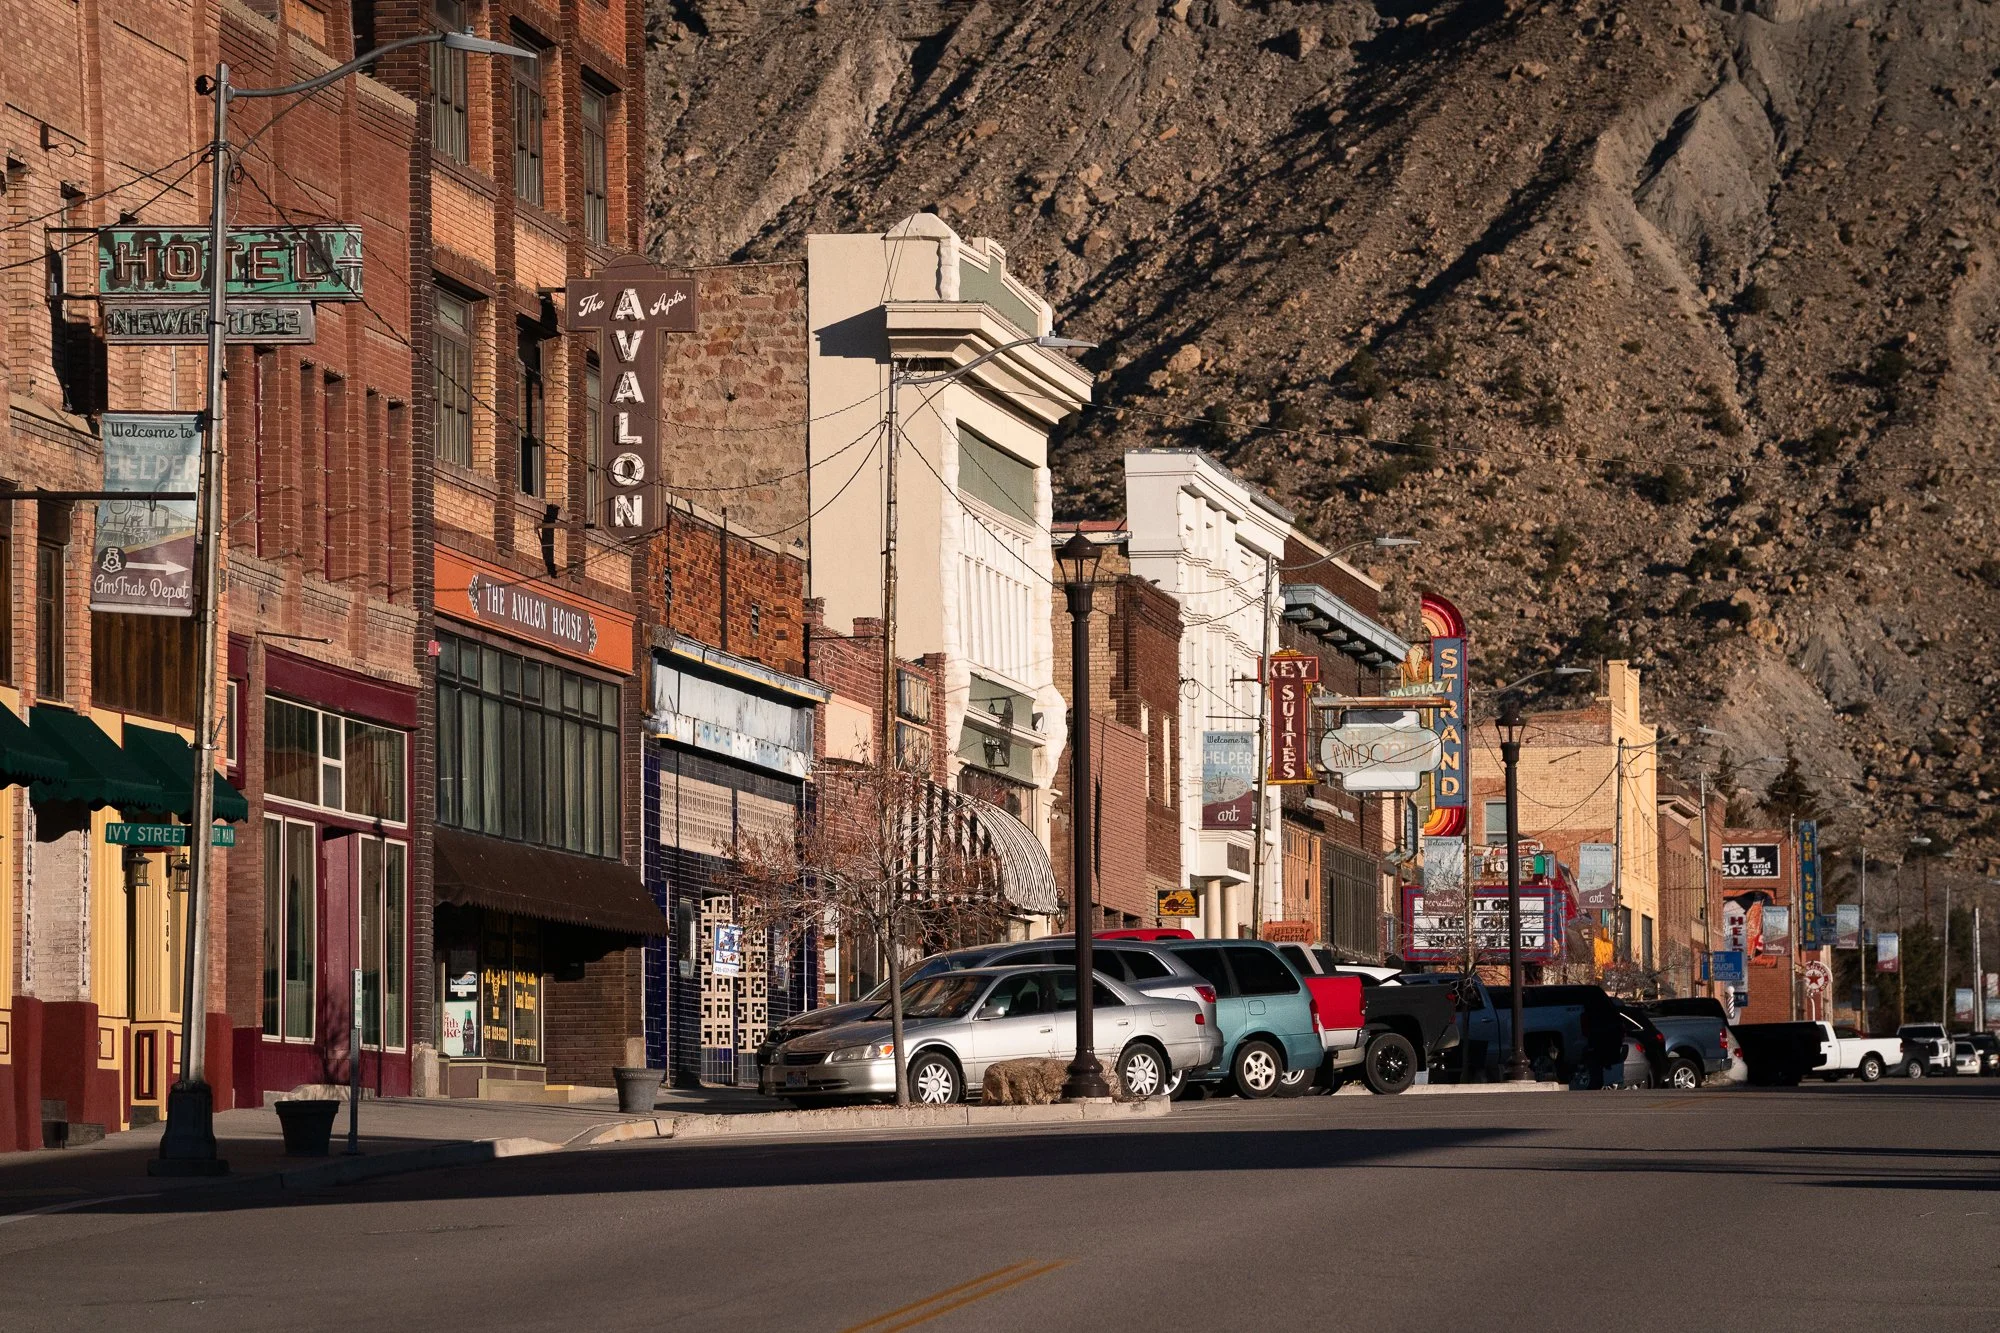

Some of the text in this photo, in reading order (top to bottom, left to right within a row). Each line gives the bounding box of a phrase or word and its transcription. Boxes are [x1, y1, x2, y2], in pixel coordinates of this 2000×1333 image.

[114, 241, 328, 282] HOTEL
[578, 293, 604, 317] The
[650, 290, 687, 316] Apts.
[611, 288, 645, 528] AVALON
[111, 423, 196, 438] Welcome to
[106, 455, 199, 480] HELPER
[150, 578, 190, 607] Depot
[485, 582, 582, 643] THE AVALON HOUSE
[1390, 681, 1445, 697] DALPIAZ
[1440, 648, 1461, 796] STRAND
[1281, 684, 1297, 779] SUITES
[1207, 736, 1250, 744] Welcome to
[1203, 751, 1252, 765] HELPER
[1230, 765, 1252, 774] CITY
[1218, 805, 1240, 822] art
[108, 826, 131, 840] IVY
[222, 829, 235, 844] MAIN
[1589, 891, 1604, 903] art
[1804, 873, 1815, 942] LINCOLN
[1274, 926, 1305, 936] HELPER
[1439, 917, 1464, 929] KEE
[1273, 929, 1311, 942] General
